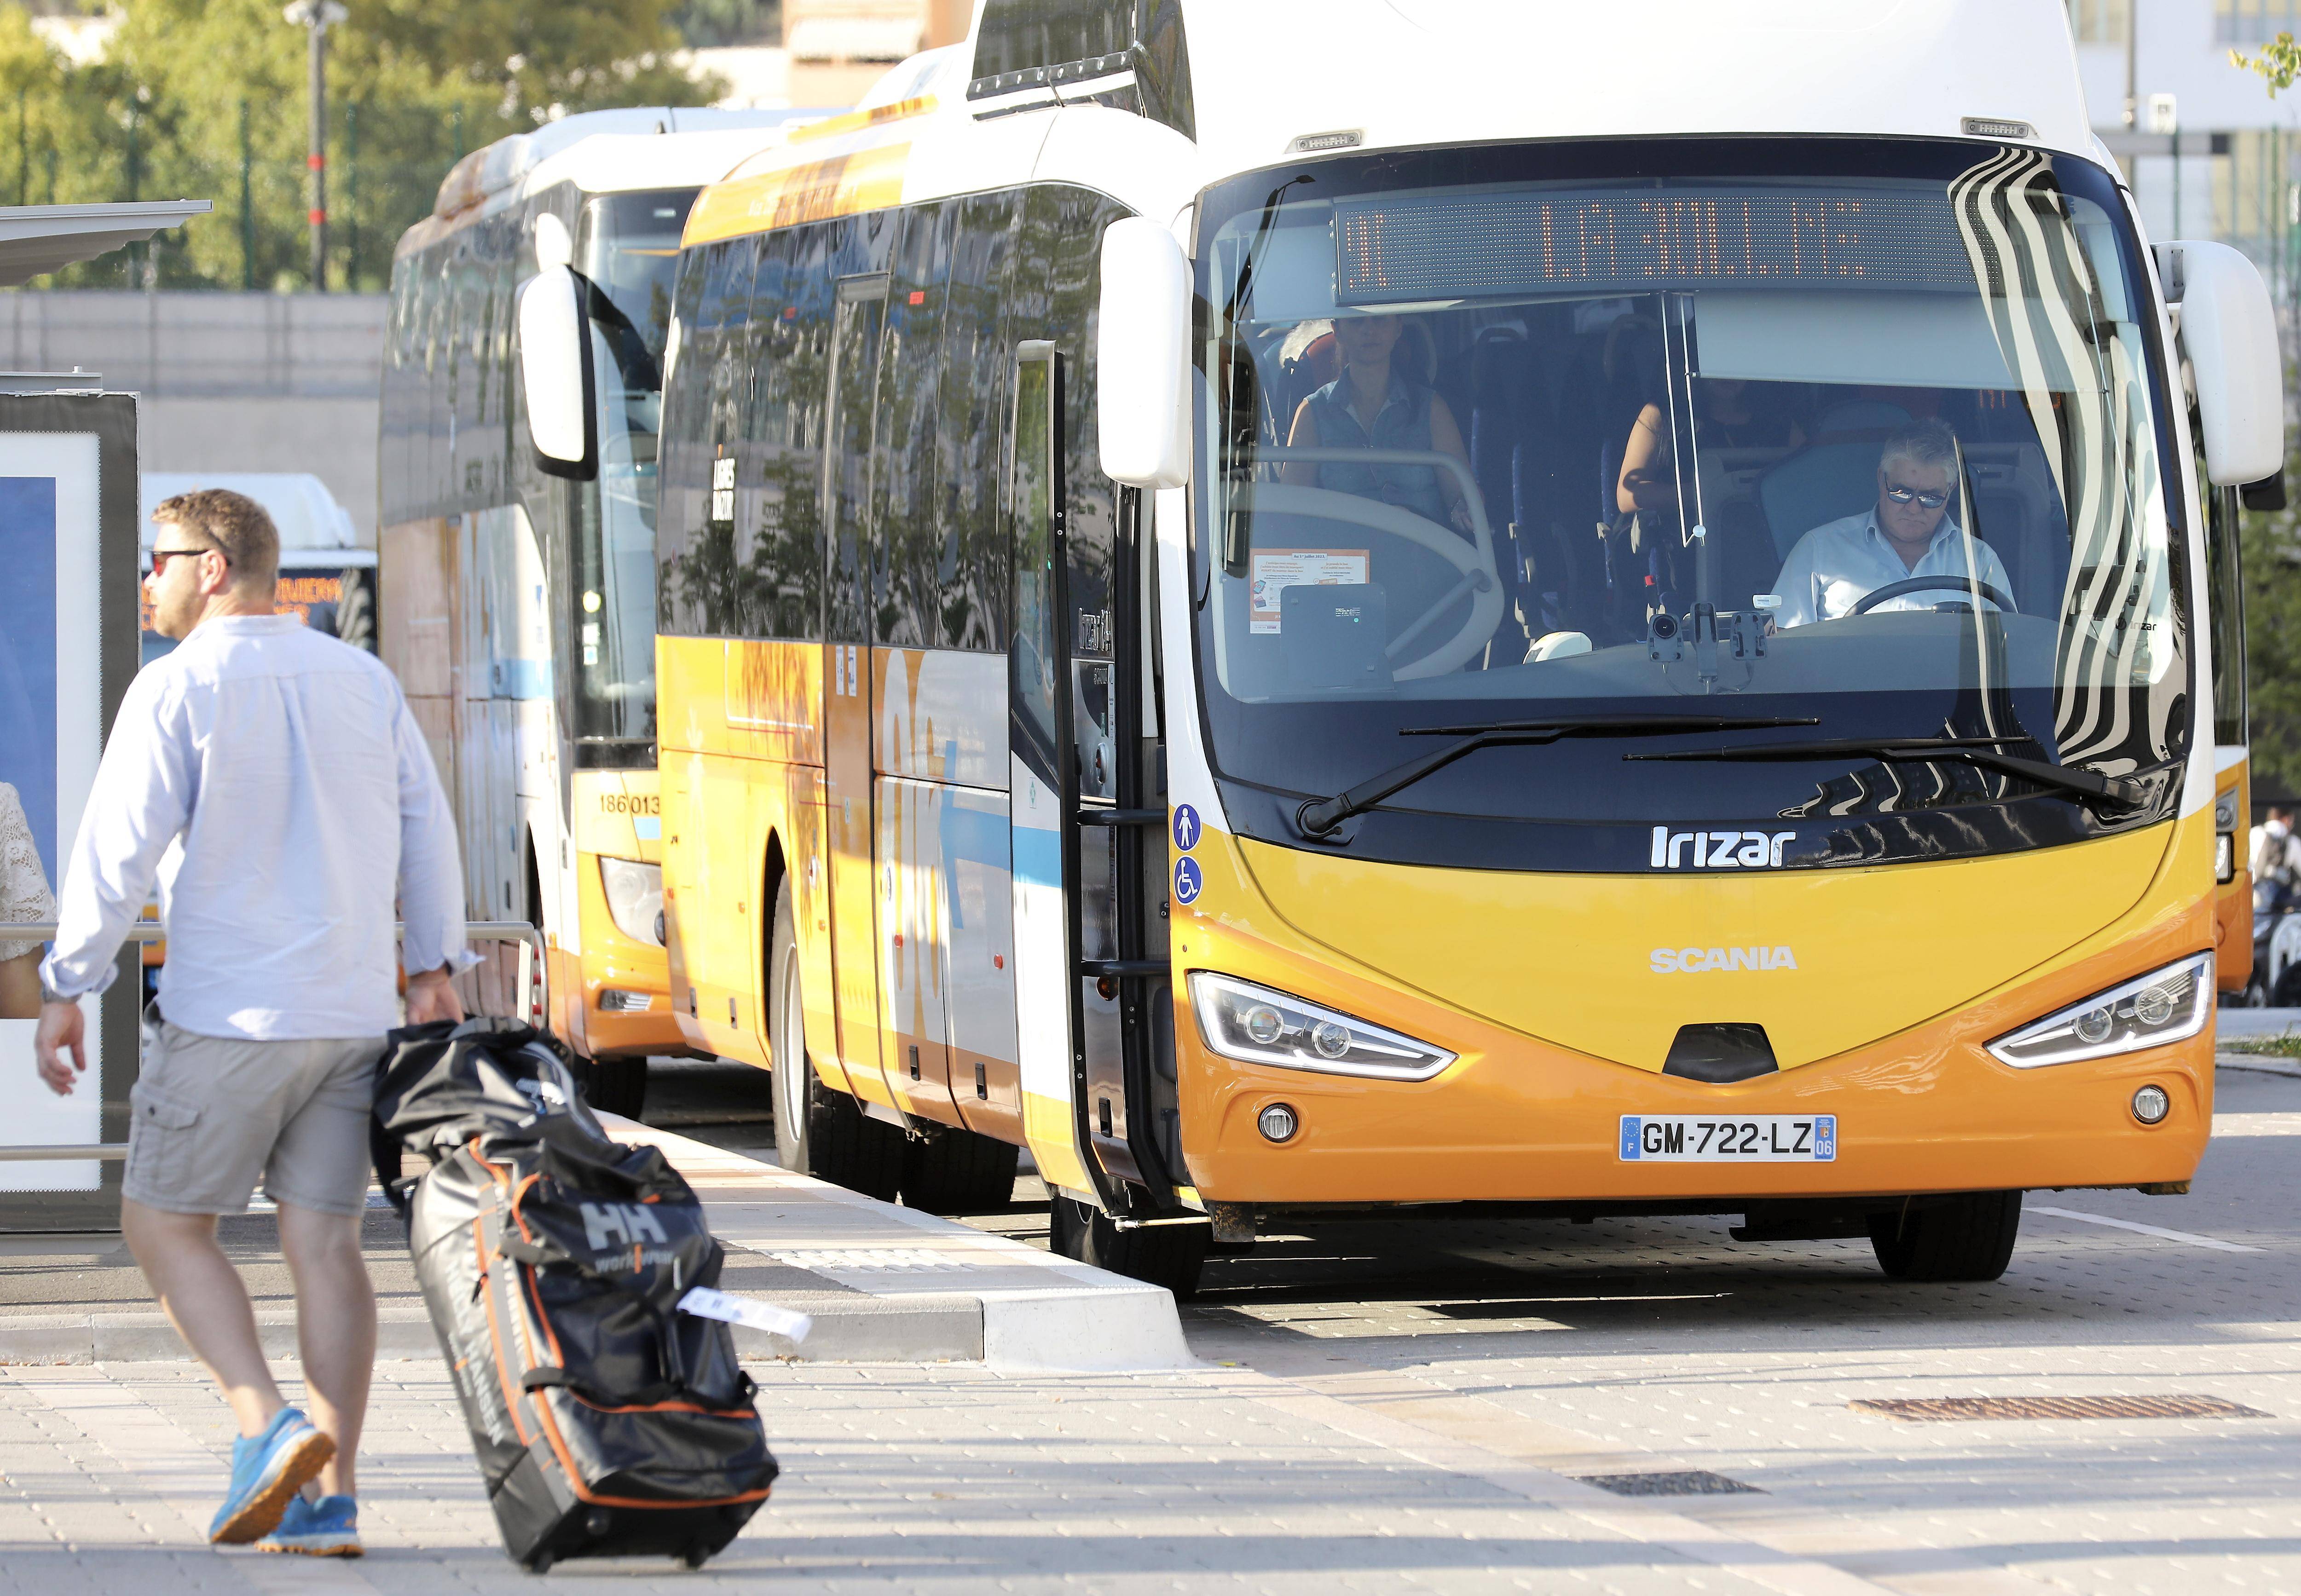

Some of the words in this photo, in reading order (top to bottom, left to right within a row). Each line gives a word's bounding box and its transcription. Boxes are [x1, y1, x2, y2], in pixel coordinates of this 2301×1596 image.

[1650, 825, 1797, 868] Irizar
[1649, 945, 1798, 974] SCANIA
[1627, 1142, 1634, 1152] F
[1643, 1123, 1811, 1153] GM-722-LZ
[1816, 1140, 1833, 1155] 06
[579, 1201, 668, 1251] HH
[464, 1340, 505, 1447] HANSEN
